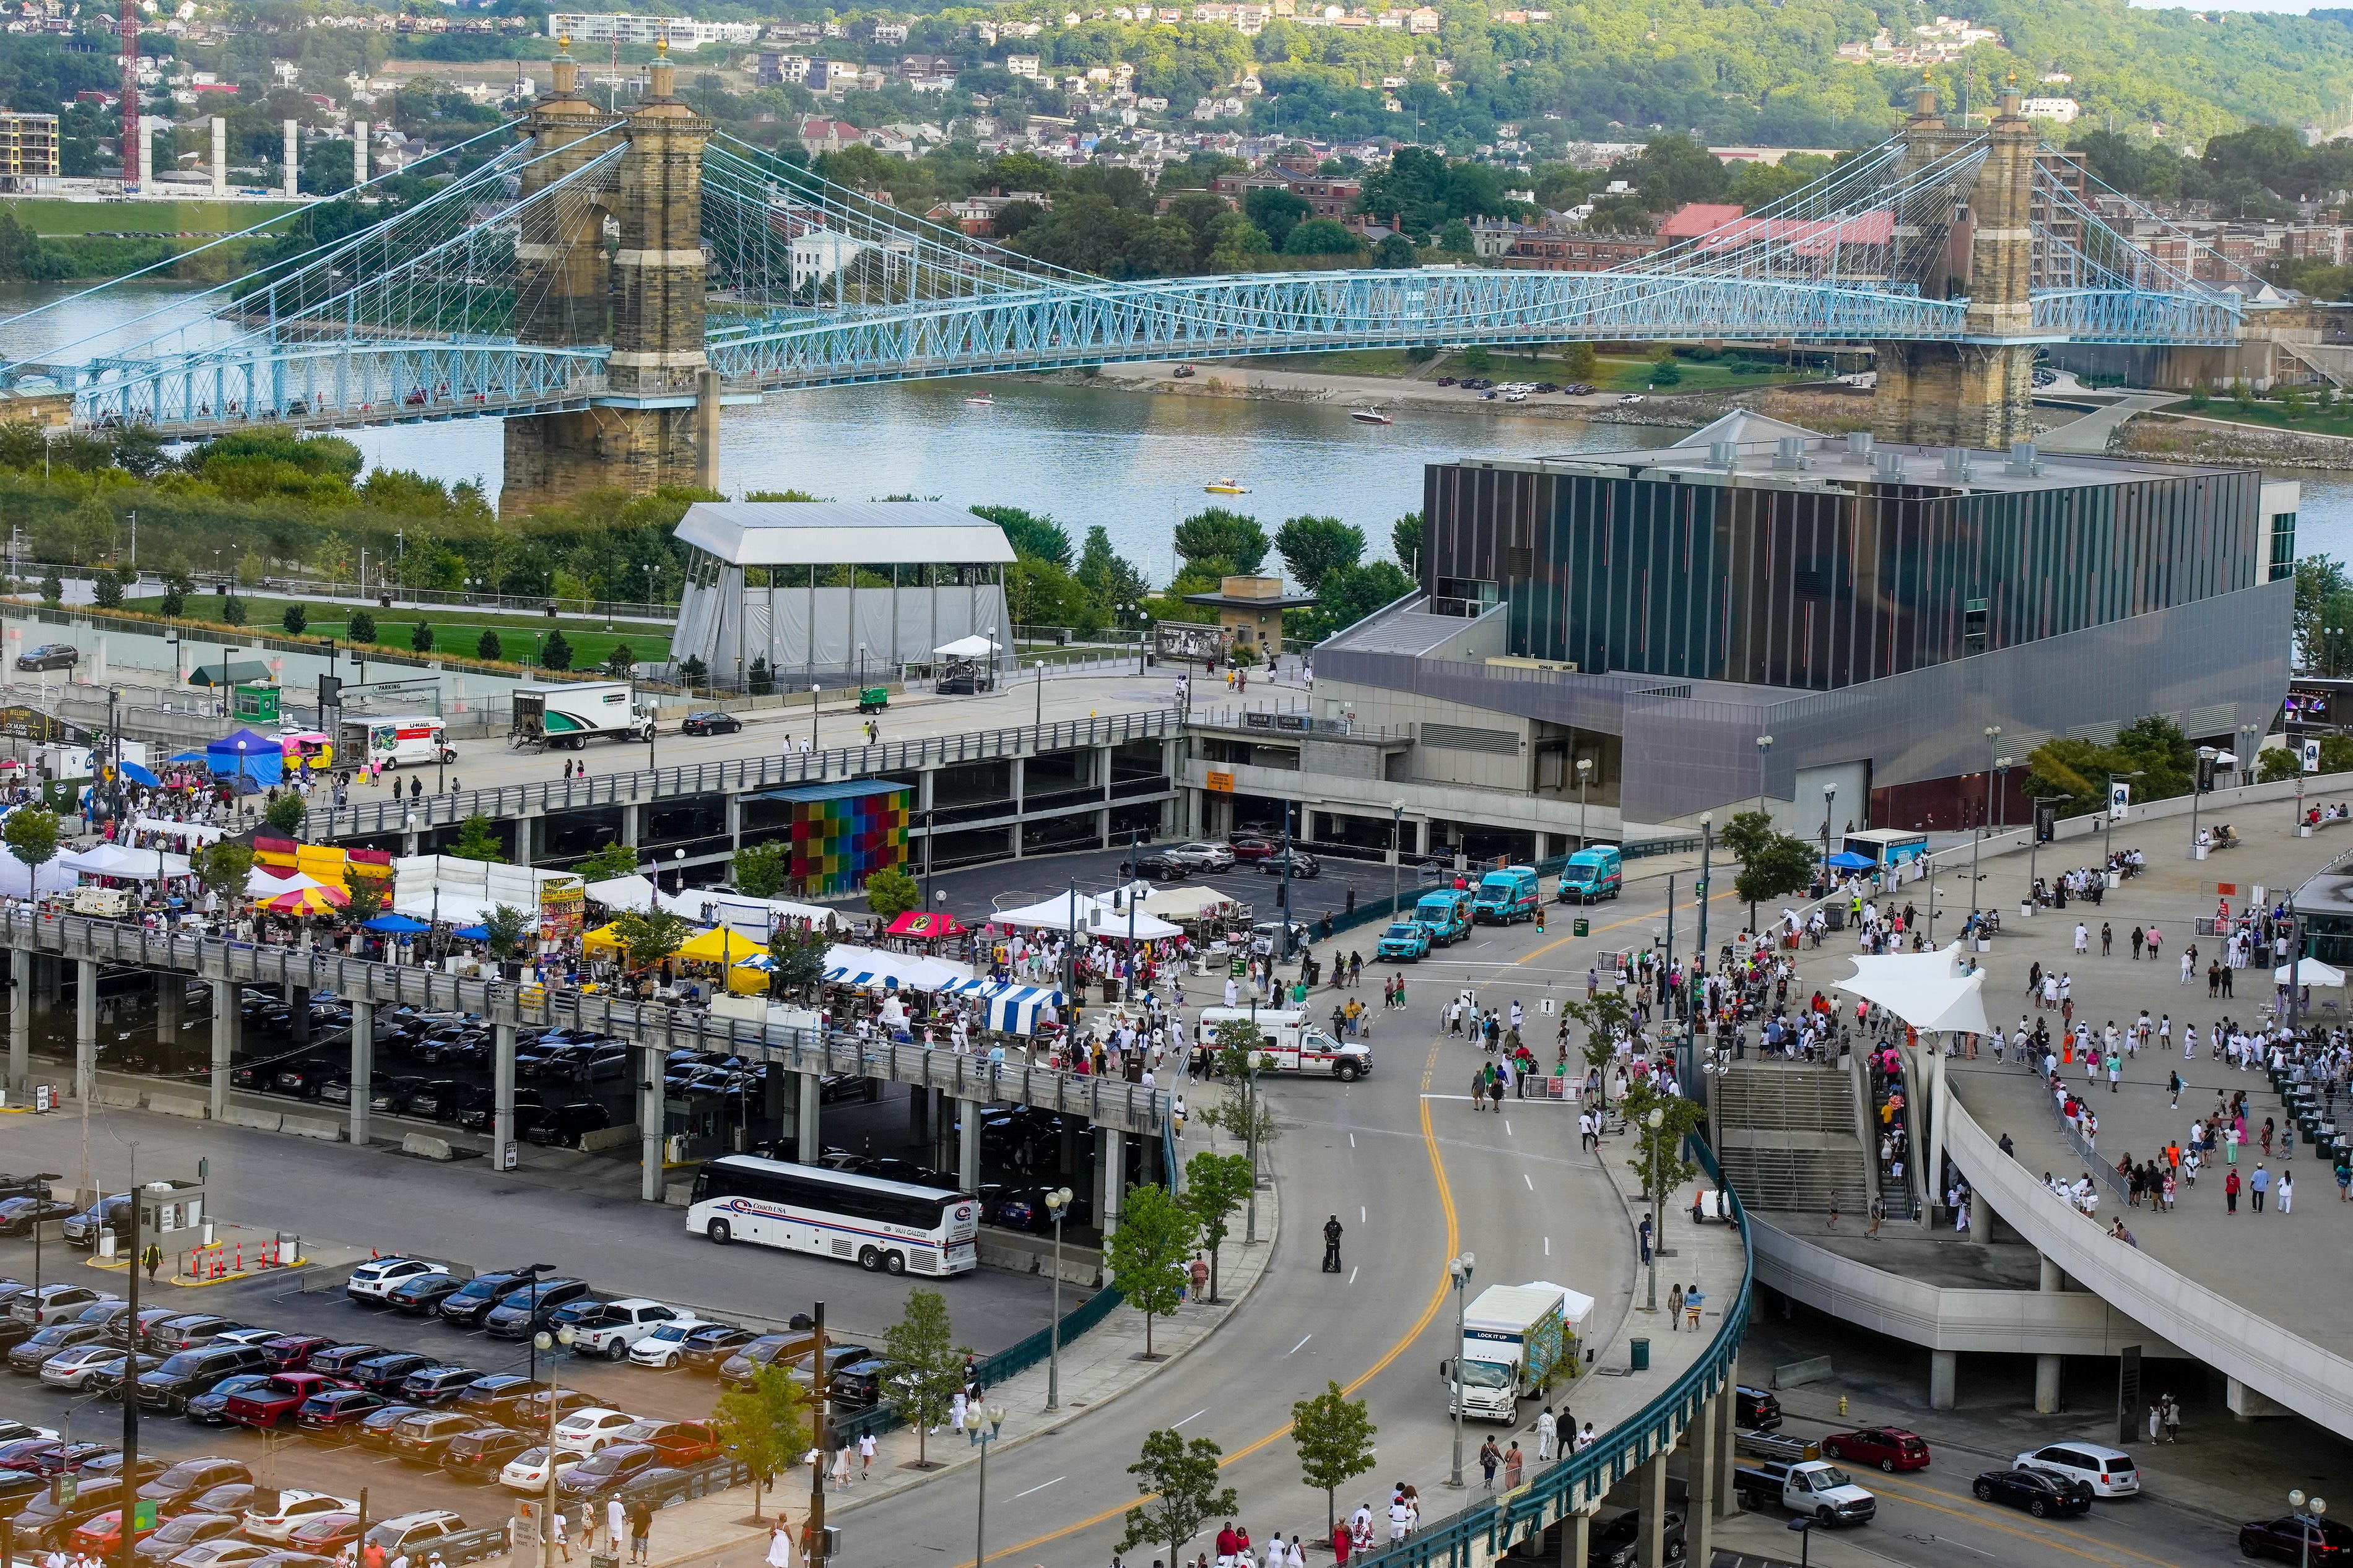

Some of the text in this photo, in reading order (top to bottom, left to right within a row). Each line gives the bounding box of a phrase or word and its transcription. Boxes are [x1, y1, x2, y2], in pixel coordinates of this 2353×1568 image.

[604, 695, 625, 703] enterprise
[9, 709, 31, 717] WELCOME
[753, 1203, 786, 1214] Coach USA
[907, 1229, 927, 1238] GALDER
